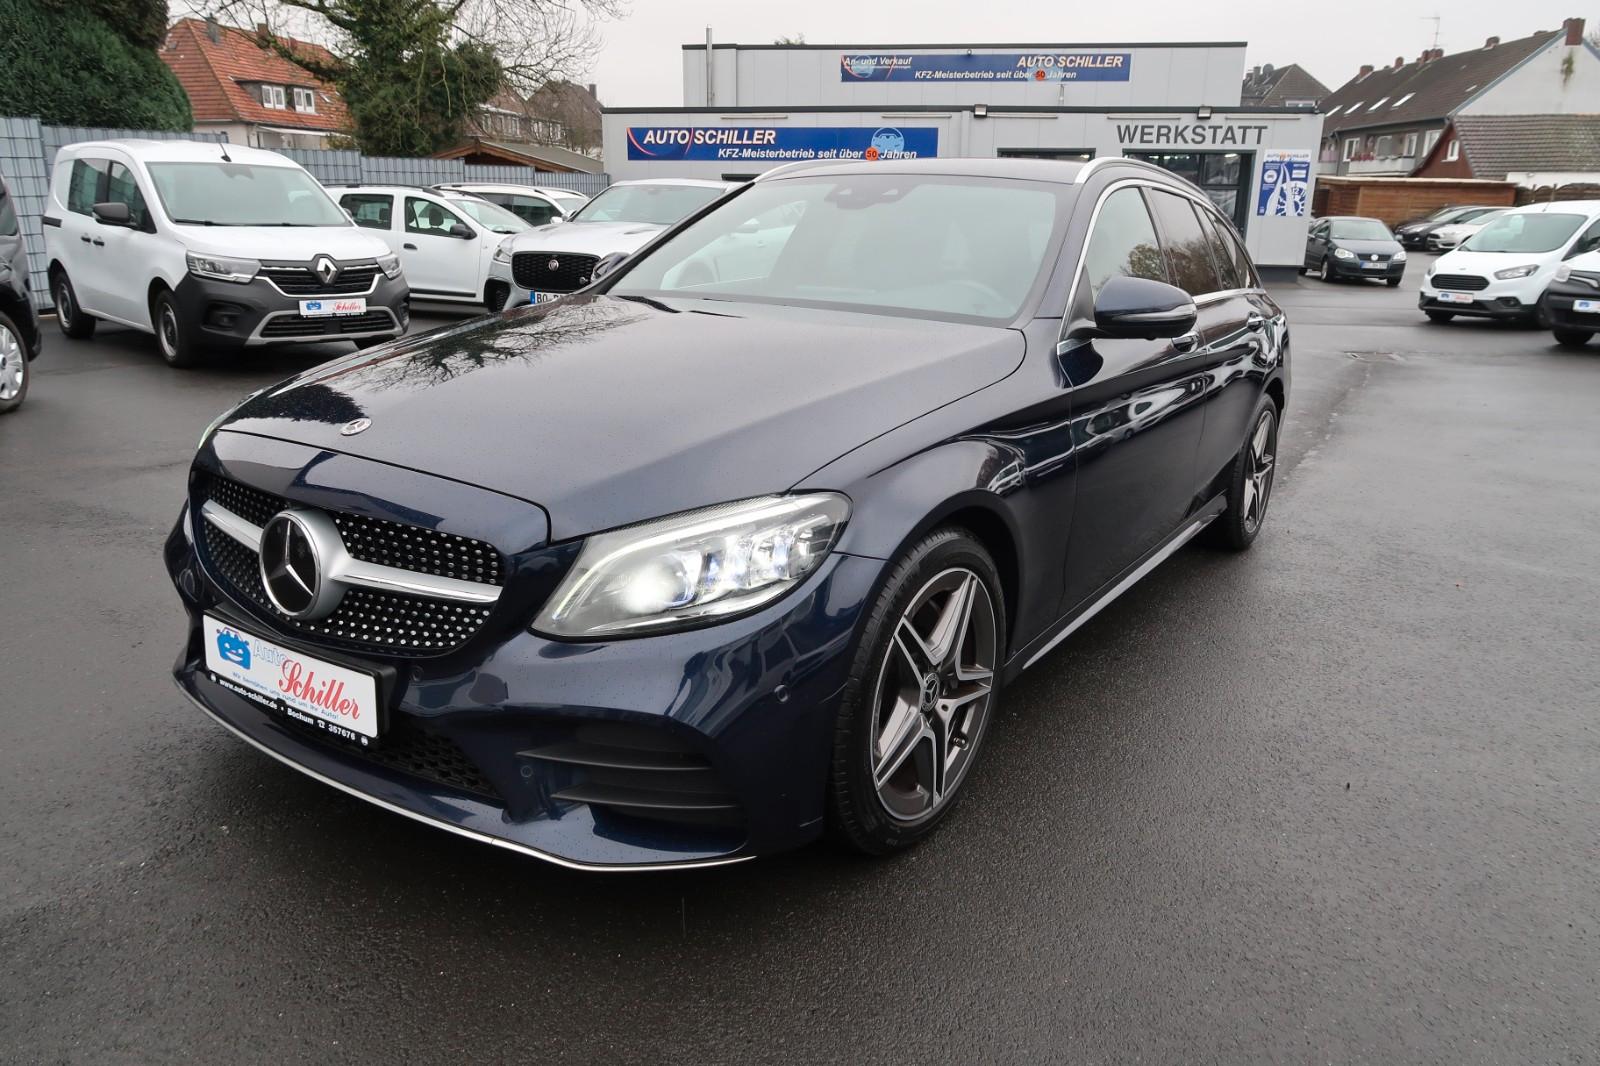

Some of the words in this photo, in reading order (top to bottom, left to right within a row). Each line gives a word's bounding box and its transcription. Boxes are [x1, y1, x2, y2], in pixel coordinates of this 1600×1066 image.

[861, 57, 878, 66] und
[880, 57, 913, 66] Verkauf
[1017, 55, 1055, 69] AUTO
[1057, 55, 1124, 68] SCHILLER
[914, 70, 994, 80] KFZ-Meisterbetrieb
[996, 71, 1012, 80] seit
[1013, 70, 1033, 80] über
[1047, 71, 1077, 80] Jahren
[643, 129, 690, 145] AUTO
[693, 129, 777, 145] SCHILLER
[1117, 124, 1268, 145] WERKSTATT
[717, 148, 815, 159] KFZ-Meisterbetrieb
[817, 148, 837, 159] seit
[839, 148, 864, 159] über
[866, 150, 878, 159] 50
[880, 149, 917, 159] Jahren
[253, 639, 290, 669] Auto
[278, 659, 361, 720] Schiller
[219, 679, 278, 711] www.auto-schiller.de
[287, 708, 314, 726] Bochum
